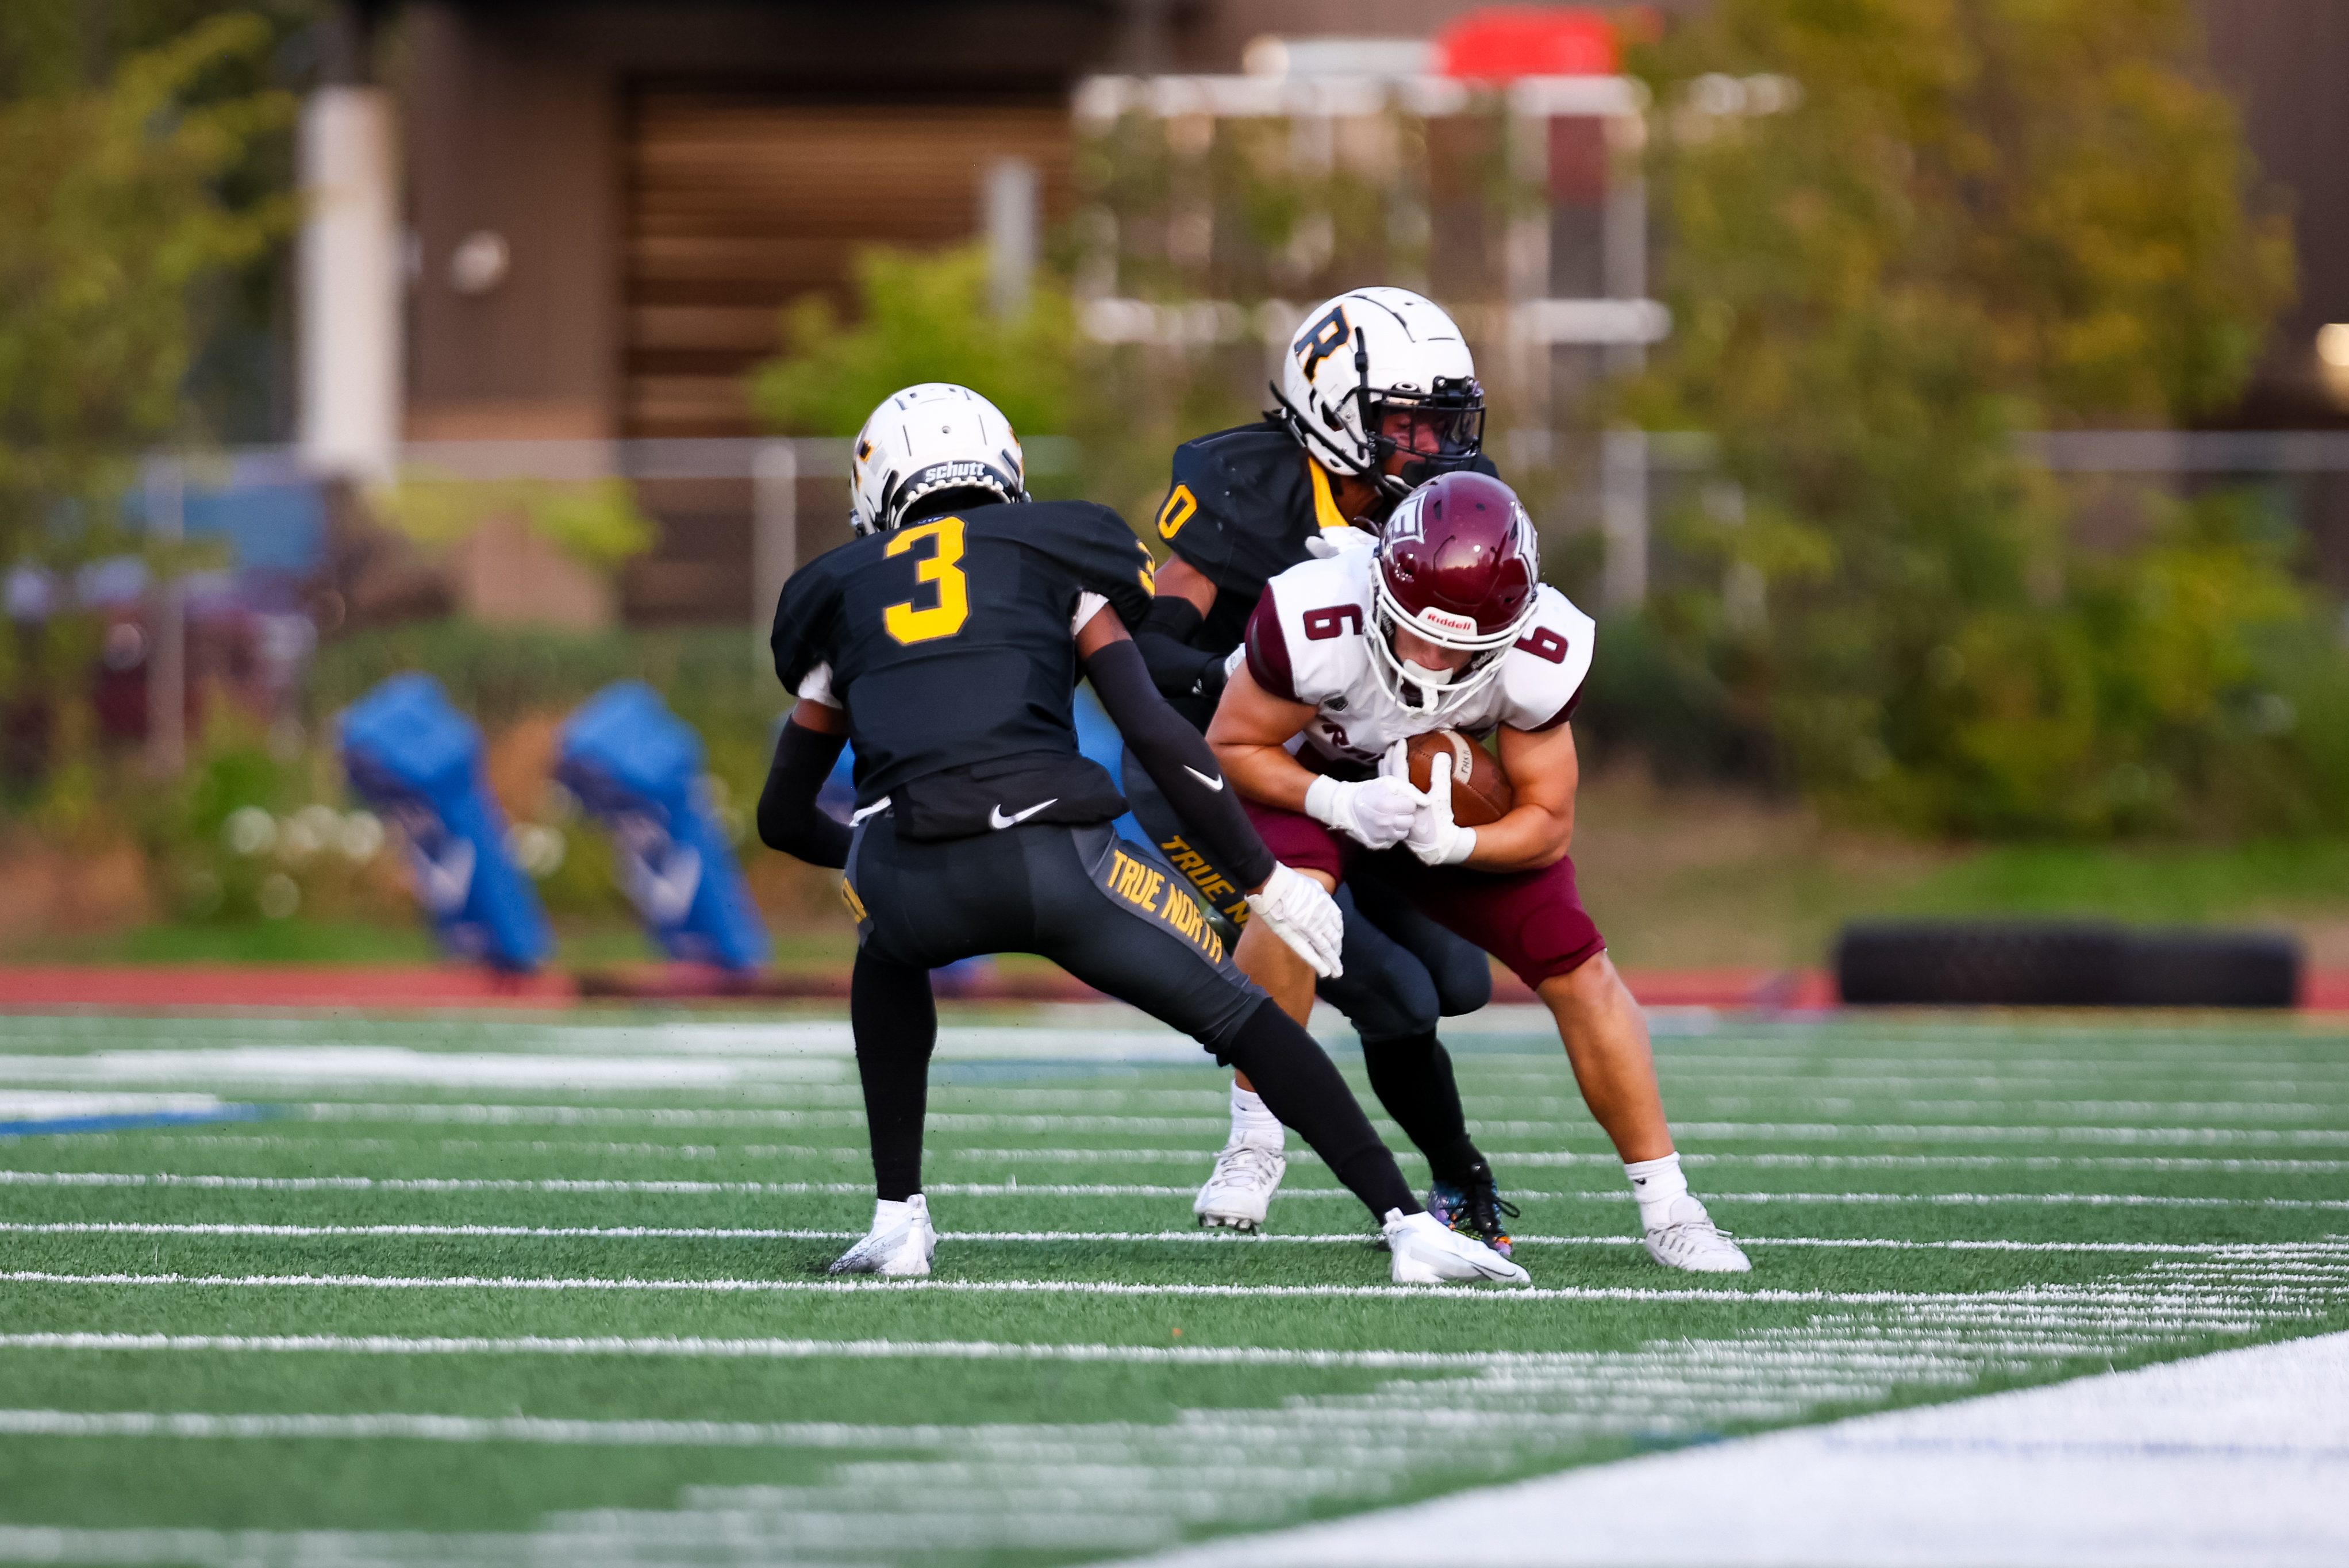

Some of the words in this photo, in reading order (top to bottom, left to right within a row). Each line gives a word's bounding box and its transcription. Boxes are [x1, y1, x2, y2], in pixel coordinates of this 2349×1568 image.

[1294, 303, 1351, 385] R
[1158, 484, 1198, 539] 0
[884, 516, 968, 644] 3
[1303, 603, 1363, 640] 6
[1427, 613, 1471, 631] Riddell
[1514, 627, 1568, 664] 6
[1161, 835, 1236, 902] TRUE
[1108, 849, 1166, 912] TRUE
[1160, 882, 1222, 964] NORTH
